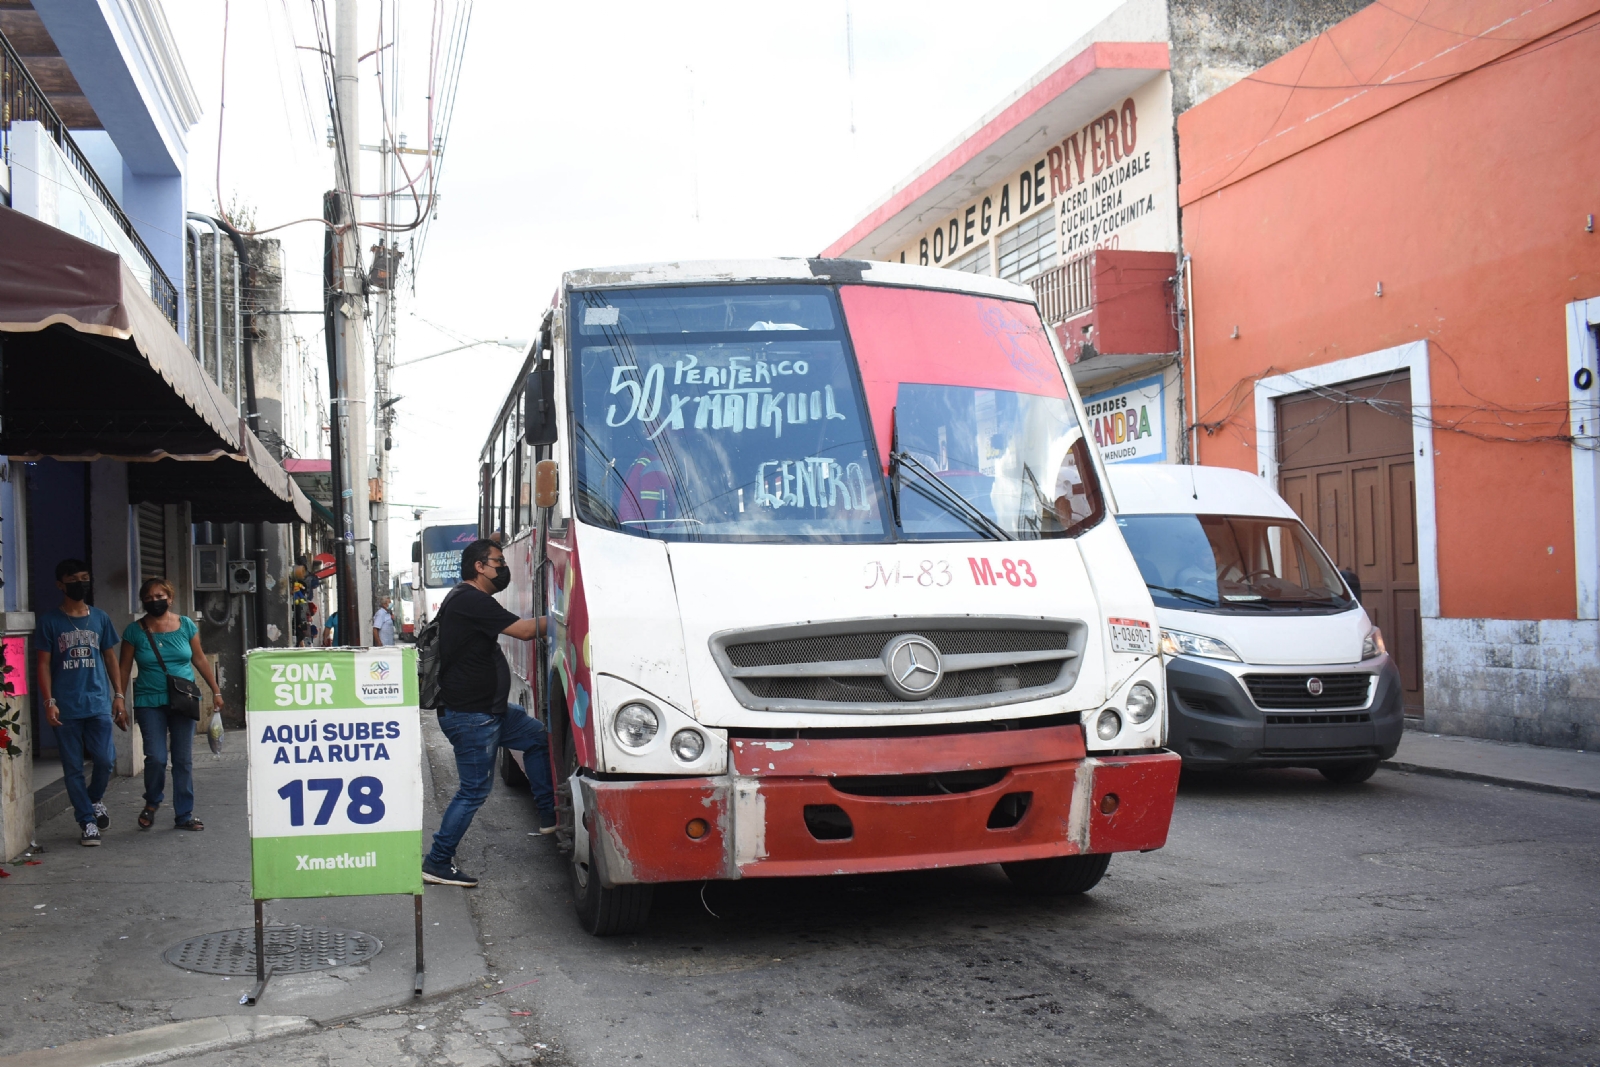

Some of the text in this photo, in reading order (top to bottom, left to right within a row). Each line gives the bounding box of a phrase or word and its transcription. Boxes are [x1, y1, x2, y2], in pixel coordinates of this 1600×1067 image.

[919, 97, 1138, 266] BODEGA DE RIVERO
[1061, 151, 1150, 217] ACERO INOXIDABLE
[1061, 190, 1122, 235] CUCHILLERIA
[1062, 229, 1089, 255] LATAS
[606, 363, 665, 427] 50
[1088, 405, 1152, 447] ANDRA
[1105, 446, 1137, 460] MENUDEO
[754, 456, 870, 511] CENTRO
[863, 557, 1038, 589] M-83 M-83
[1112, 625, 1153, 644] A-03690-Z
[63, 659, 80, 669] NEW
[271, 663, 336, 682] ZONA
[274, 683, 334, 706] SUR
[361, 686, 399, 695] Yucatán
[261, 719, 401, 744] AQUÍ SUBES
[273, 743, 390, 764] A LA RUTA
[277, 775, 386, 827] 178
[295, 851, 377, 871] Xmatkuil
